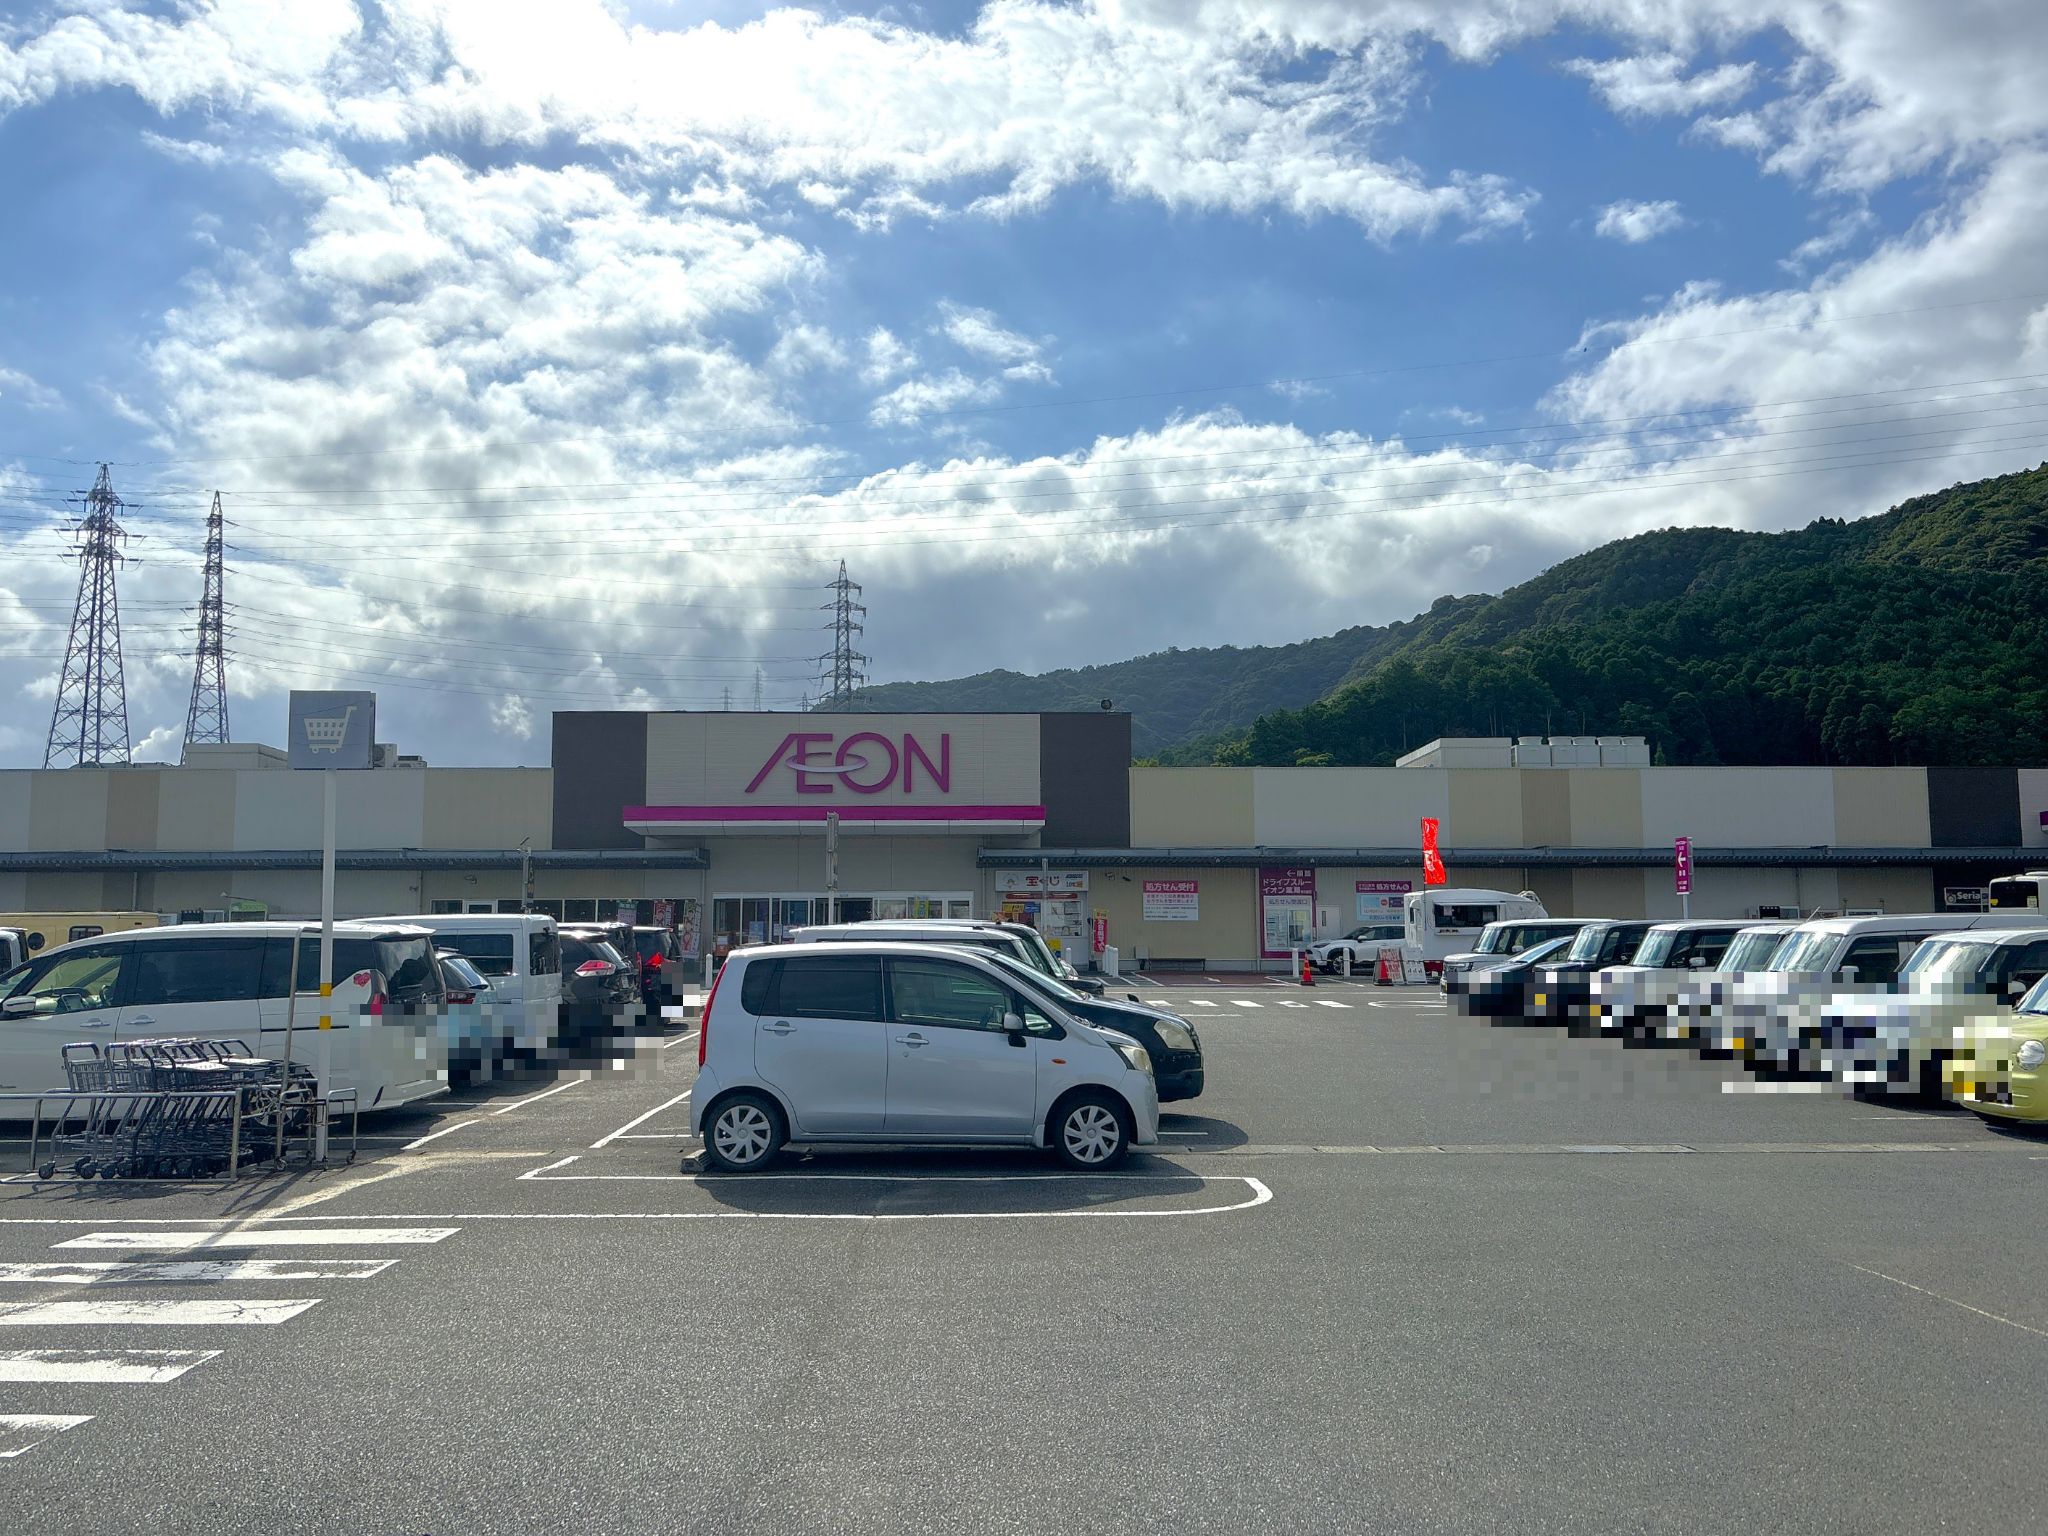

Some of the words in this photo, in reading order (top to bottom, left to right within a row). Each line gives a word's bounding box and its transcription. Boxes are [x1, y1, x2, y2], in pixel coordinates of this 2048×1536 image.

[1145, 882, 1194, 891] 処方せん受付
[1263, 878, 1312, 886] ドライブスルー
[1956, 891, 1981, 900] Seria
